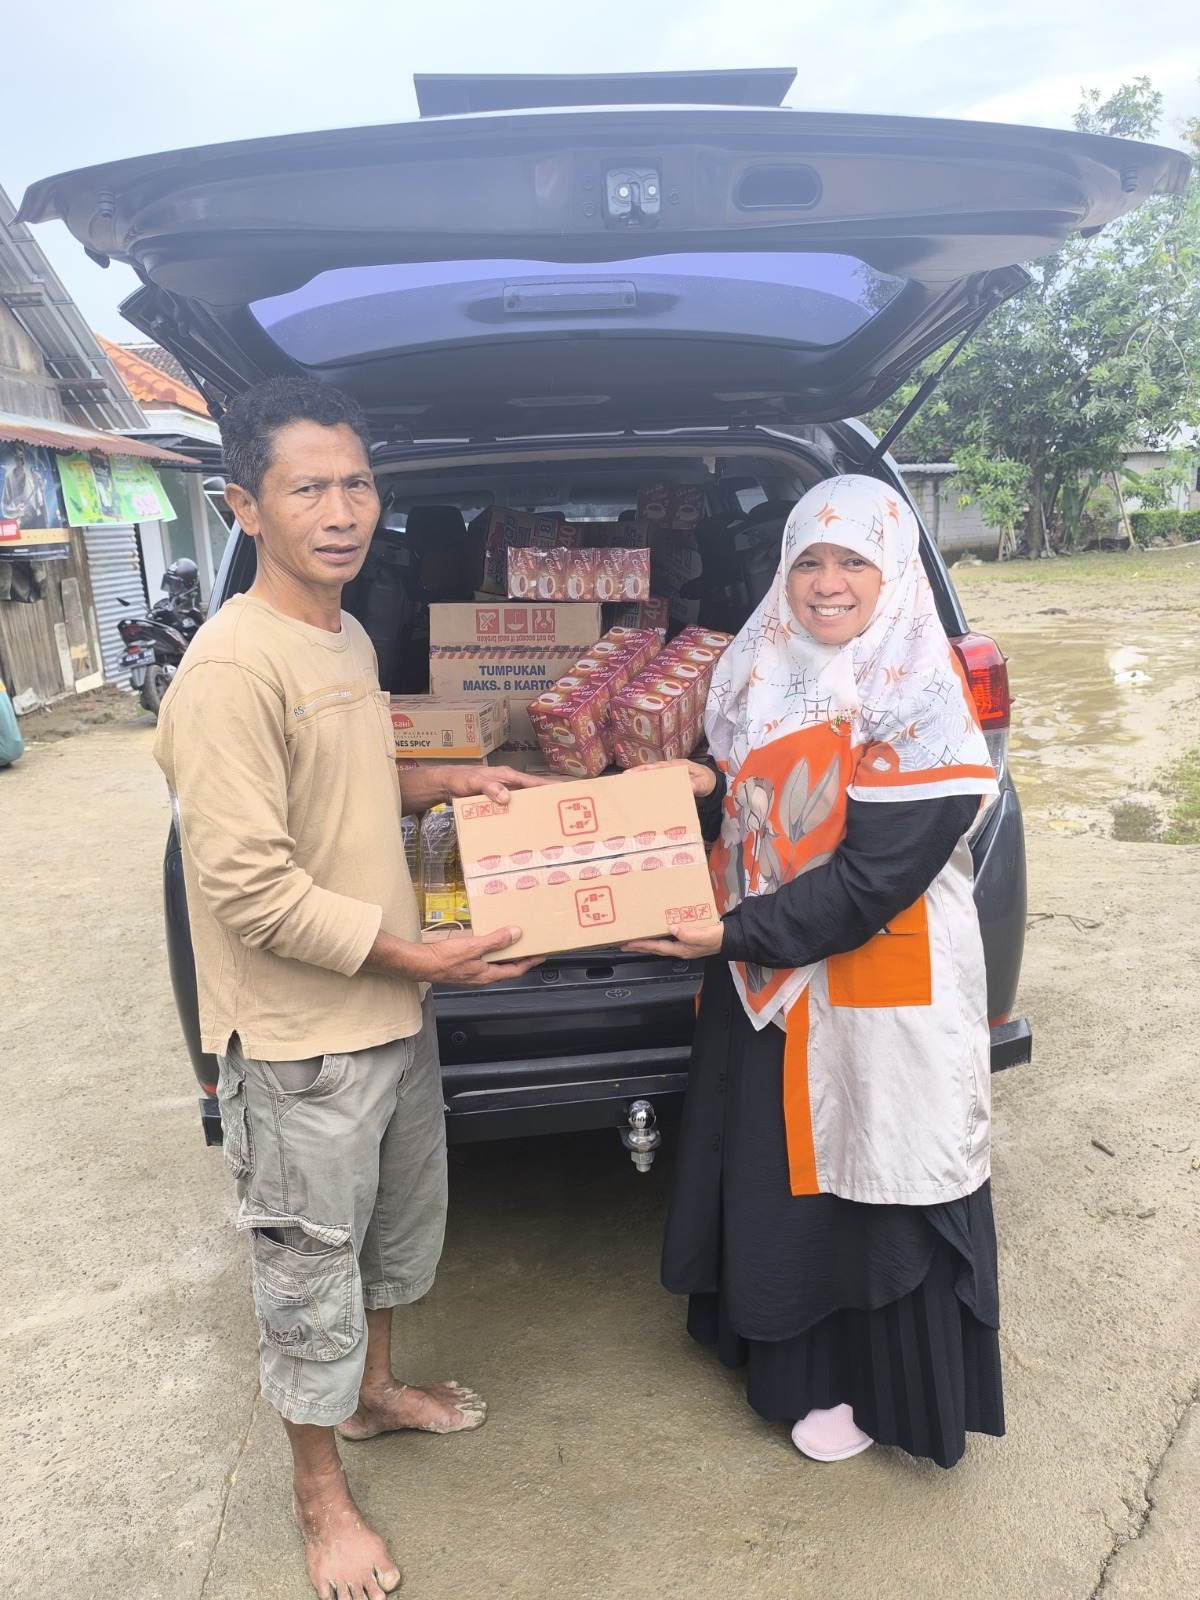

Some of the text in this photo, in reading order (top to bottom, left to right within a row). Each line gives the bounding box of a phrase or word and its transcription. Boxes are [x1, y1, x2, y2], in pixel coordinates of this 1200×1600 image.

[548, 634, 555, 642] Do
[479, 666, 546, 676] TUMPUKAN
[463, 680, 557, 690] MAKS. 8 KARTO
